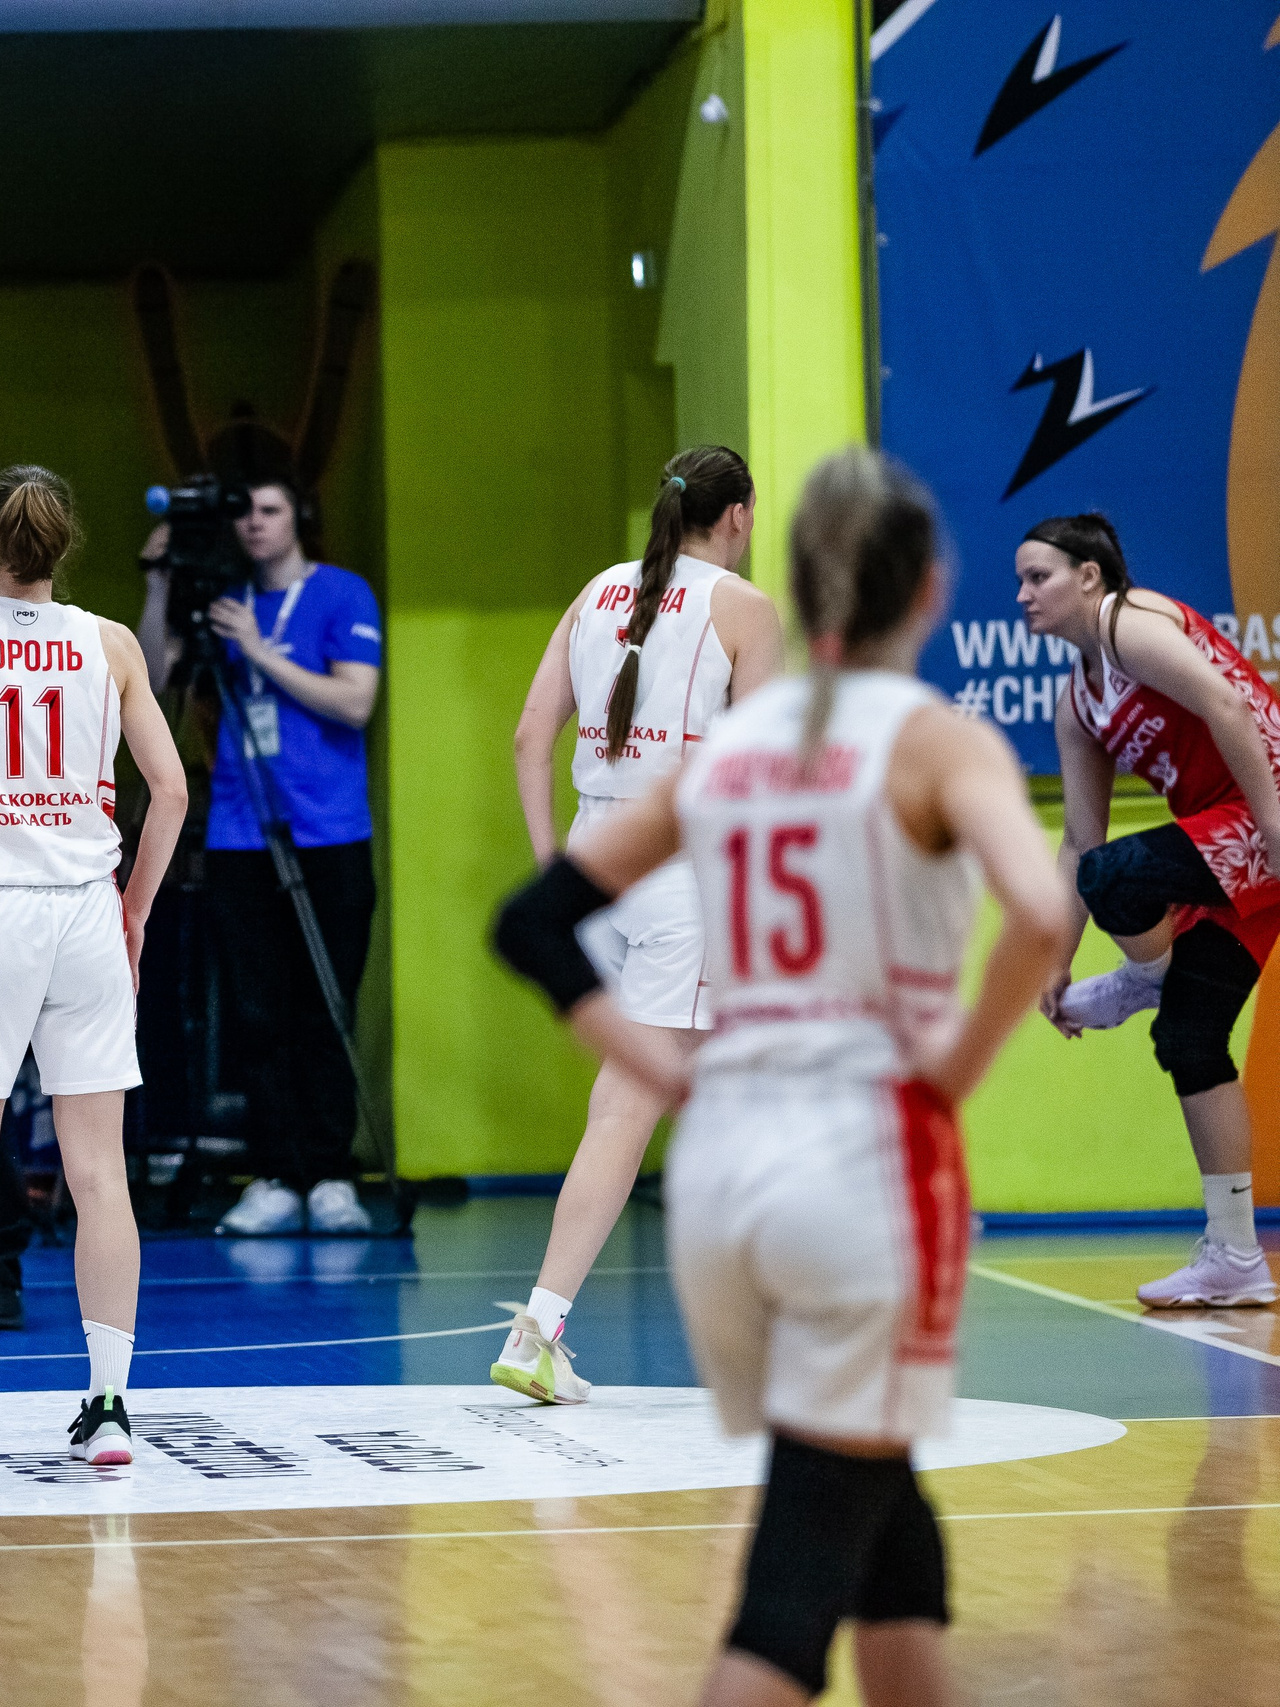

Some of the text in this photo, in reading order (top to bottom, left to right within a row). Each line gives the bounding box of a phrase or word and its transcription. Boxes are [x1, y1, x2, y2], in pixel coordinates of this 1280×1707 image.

[16, 609, 36, 618] РФБ
[723, 823, 826, 982] 15
[314, 1430, 486, 1473] СПОРТА
